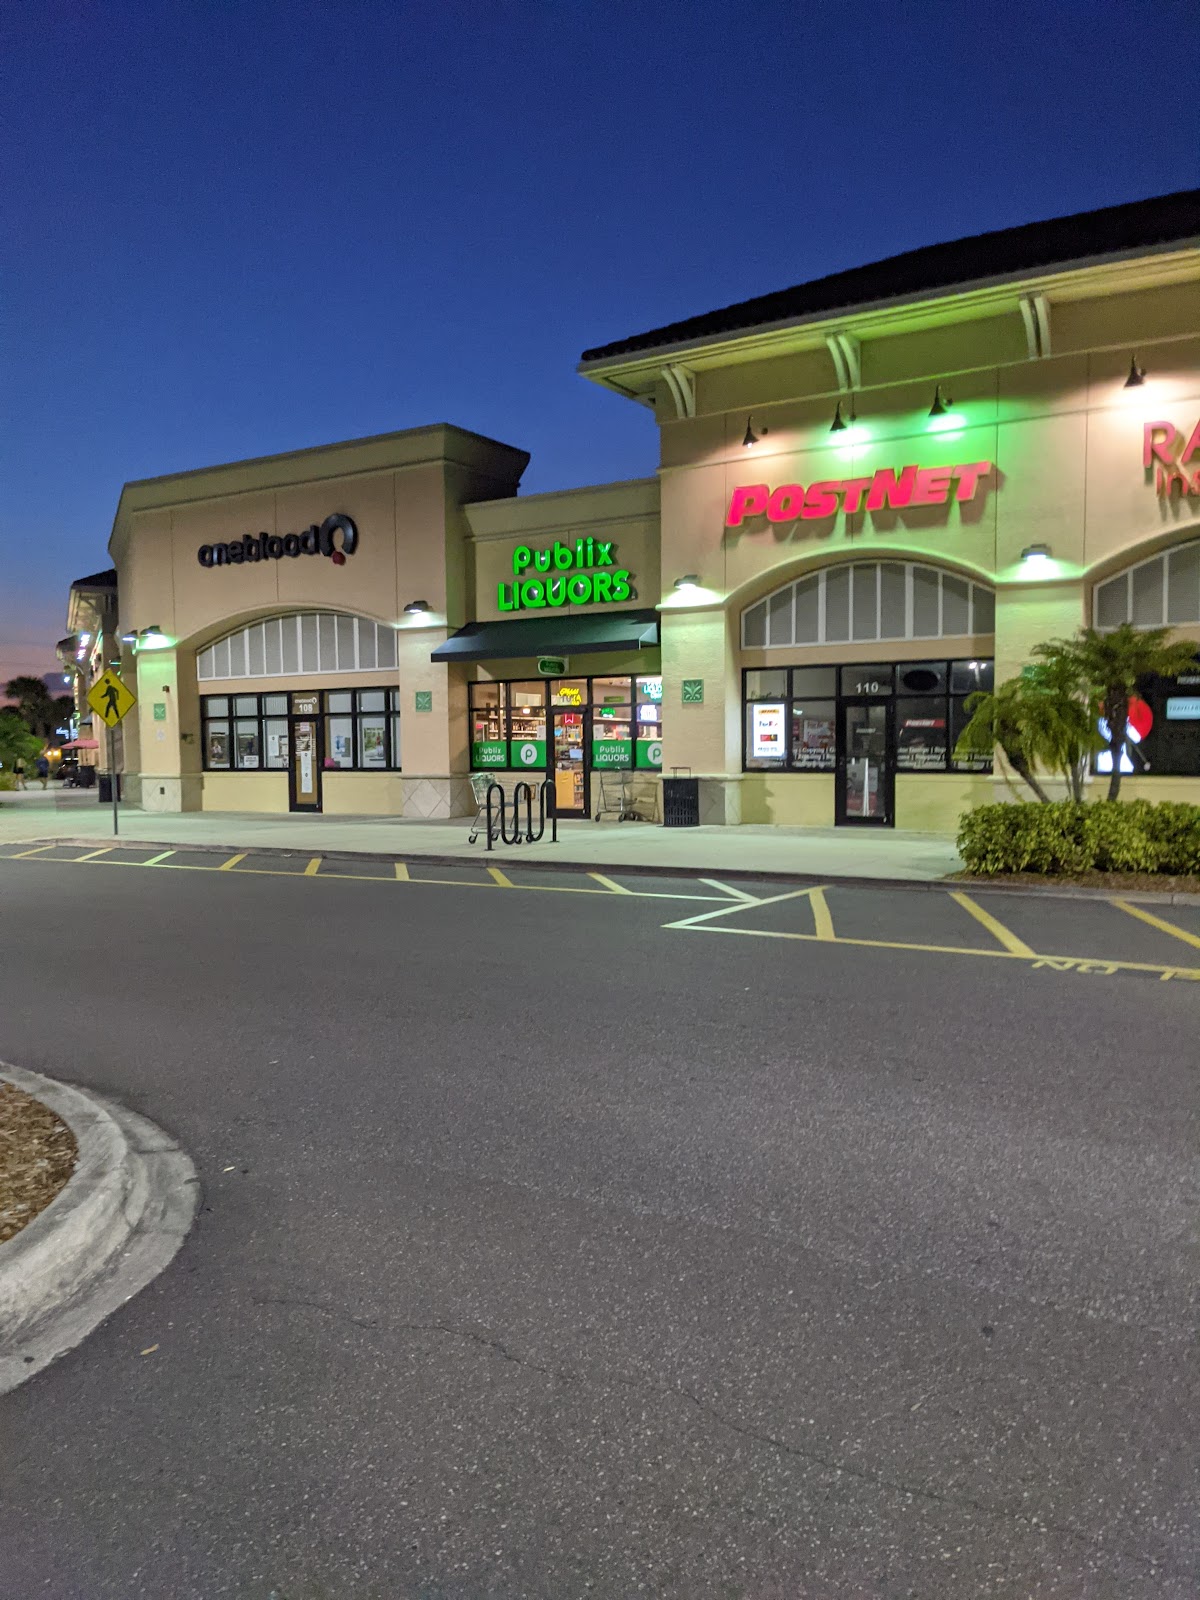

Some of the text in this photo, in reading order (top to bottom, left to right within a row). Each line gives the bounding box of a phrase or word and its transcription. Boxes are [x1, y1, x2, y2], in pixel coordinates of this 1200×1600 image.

[198, 525, 321, 567] oneblood
[512, 536, 614, 575] Publix
[498, 569, 631, 612] LIQUORS
[855, 681, 879, 694] 110
[298, 703, 313, 712] 108
[479, 747, 501, 755] Publix
[599, 746, 625, 754] Publix
[476, 754, 505, 763] LIQUORS
[595, 754, 629, 762] LIQUORS
